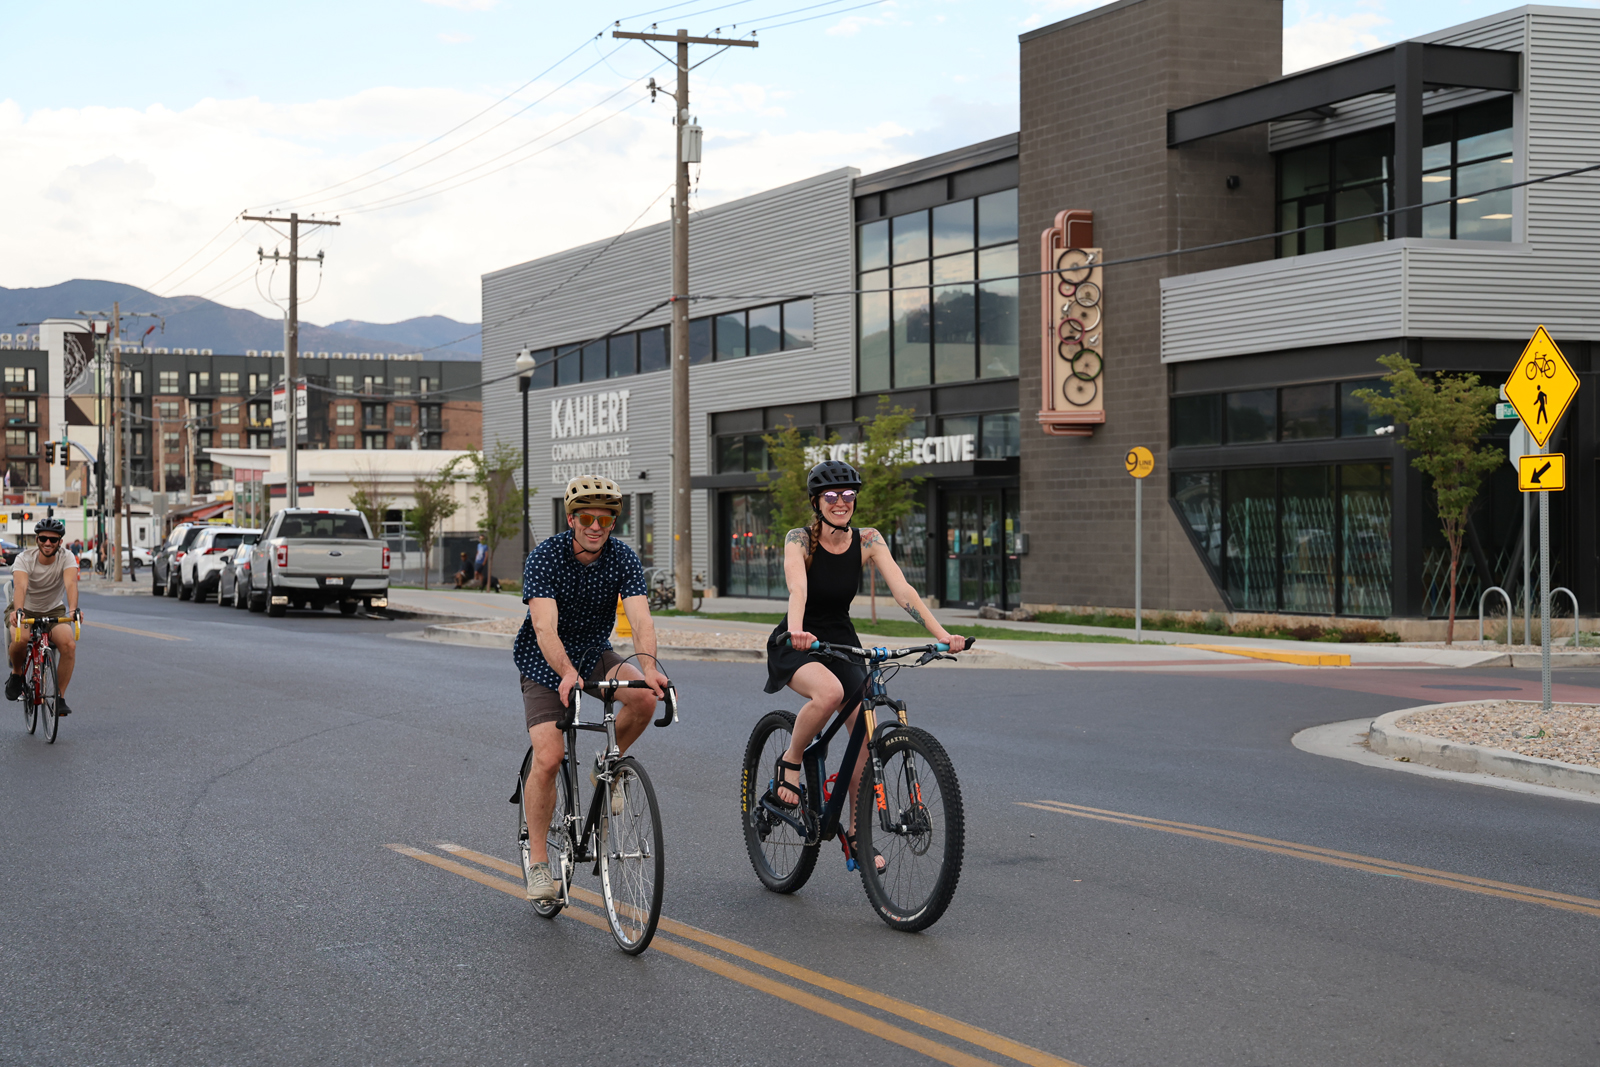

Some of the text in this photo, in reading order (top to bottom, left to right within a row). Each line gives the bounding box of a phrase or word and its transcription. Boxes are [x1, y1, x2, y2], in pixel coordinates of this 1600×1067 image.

[551, 389, 630, 439] KAHLERT
[552, 437, 630, 461] COMMUNITY BICYCLE
[1125, 451, 1139, 473] 9
[885, 735, 909, 747] MAXXIS
[873, 783, 887, 812] FOX
